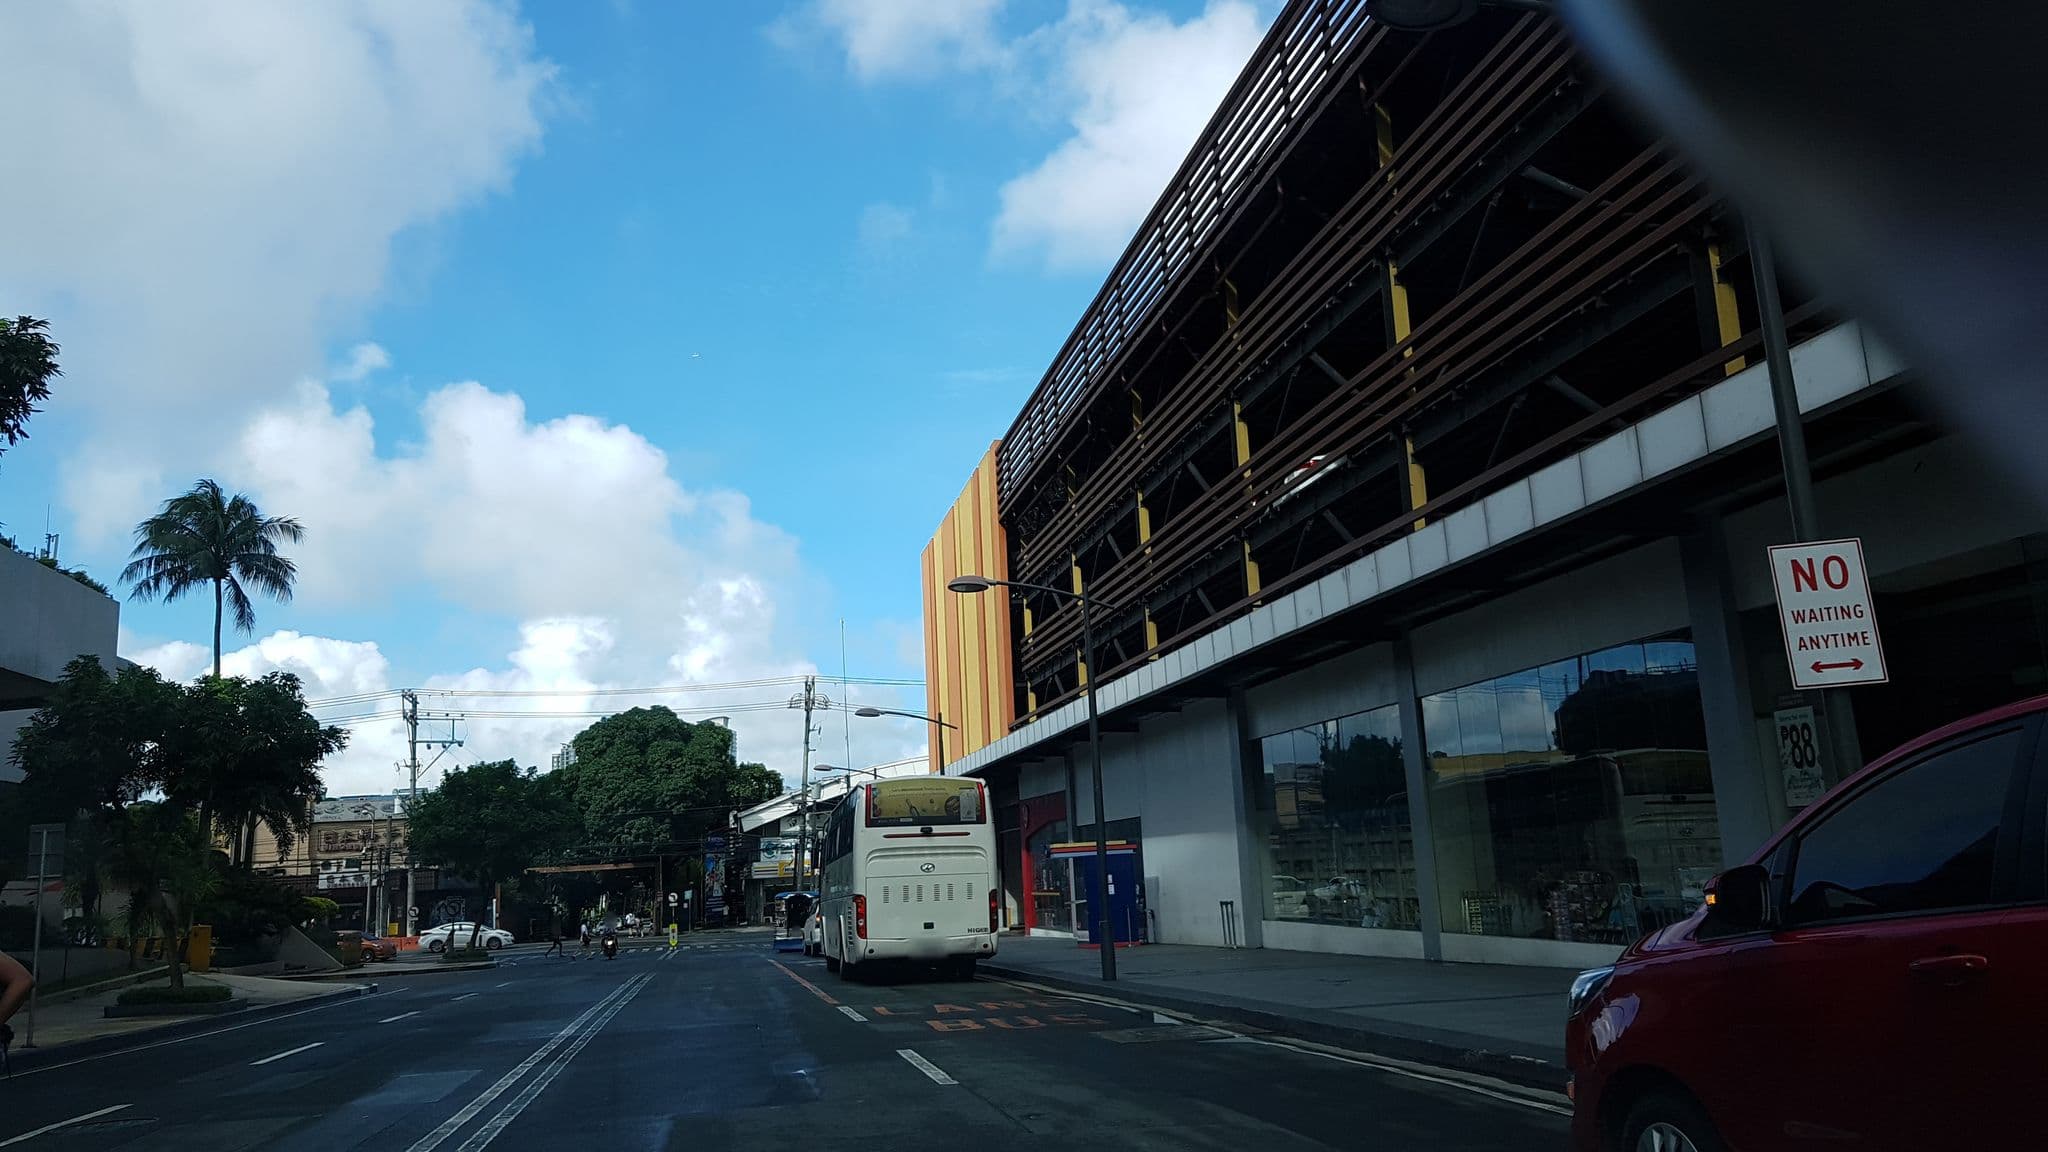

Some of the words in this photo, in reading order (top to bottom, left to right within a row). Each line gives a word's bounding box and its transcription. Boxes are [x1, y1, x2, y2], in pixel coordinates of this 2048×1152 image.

[1790, 555, 1850, 593] NO
[1791, 604, 1864, 625] WAITING
[1798, 631, 1871, 651] ANYTIME
[925, 1013, 1109, 1032] BUS
